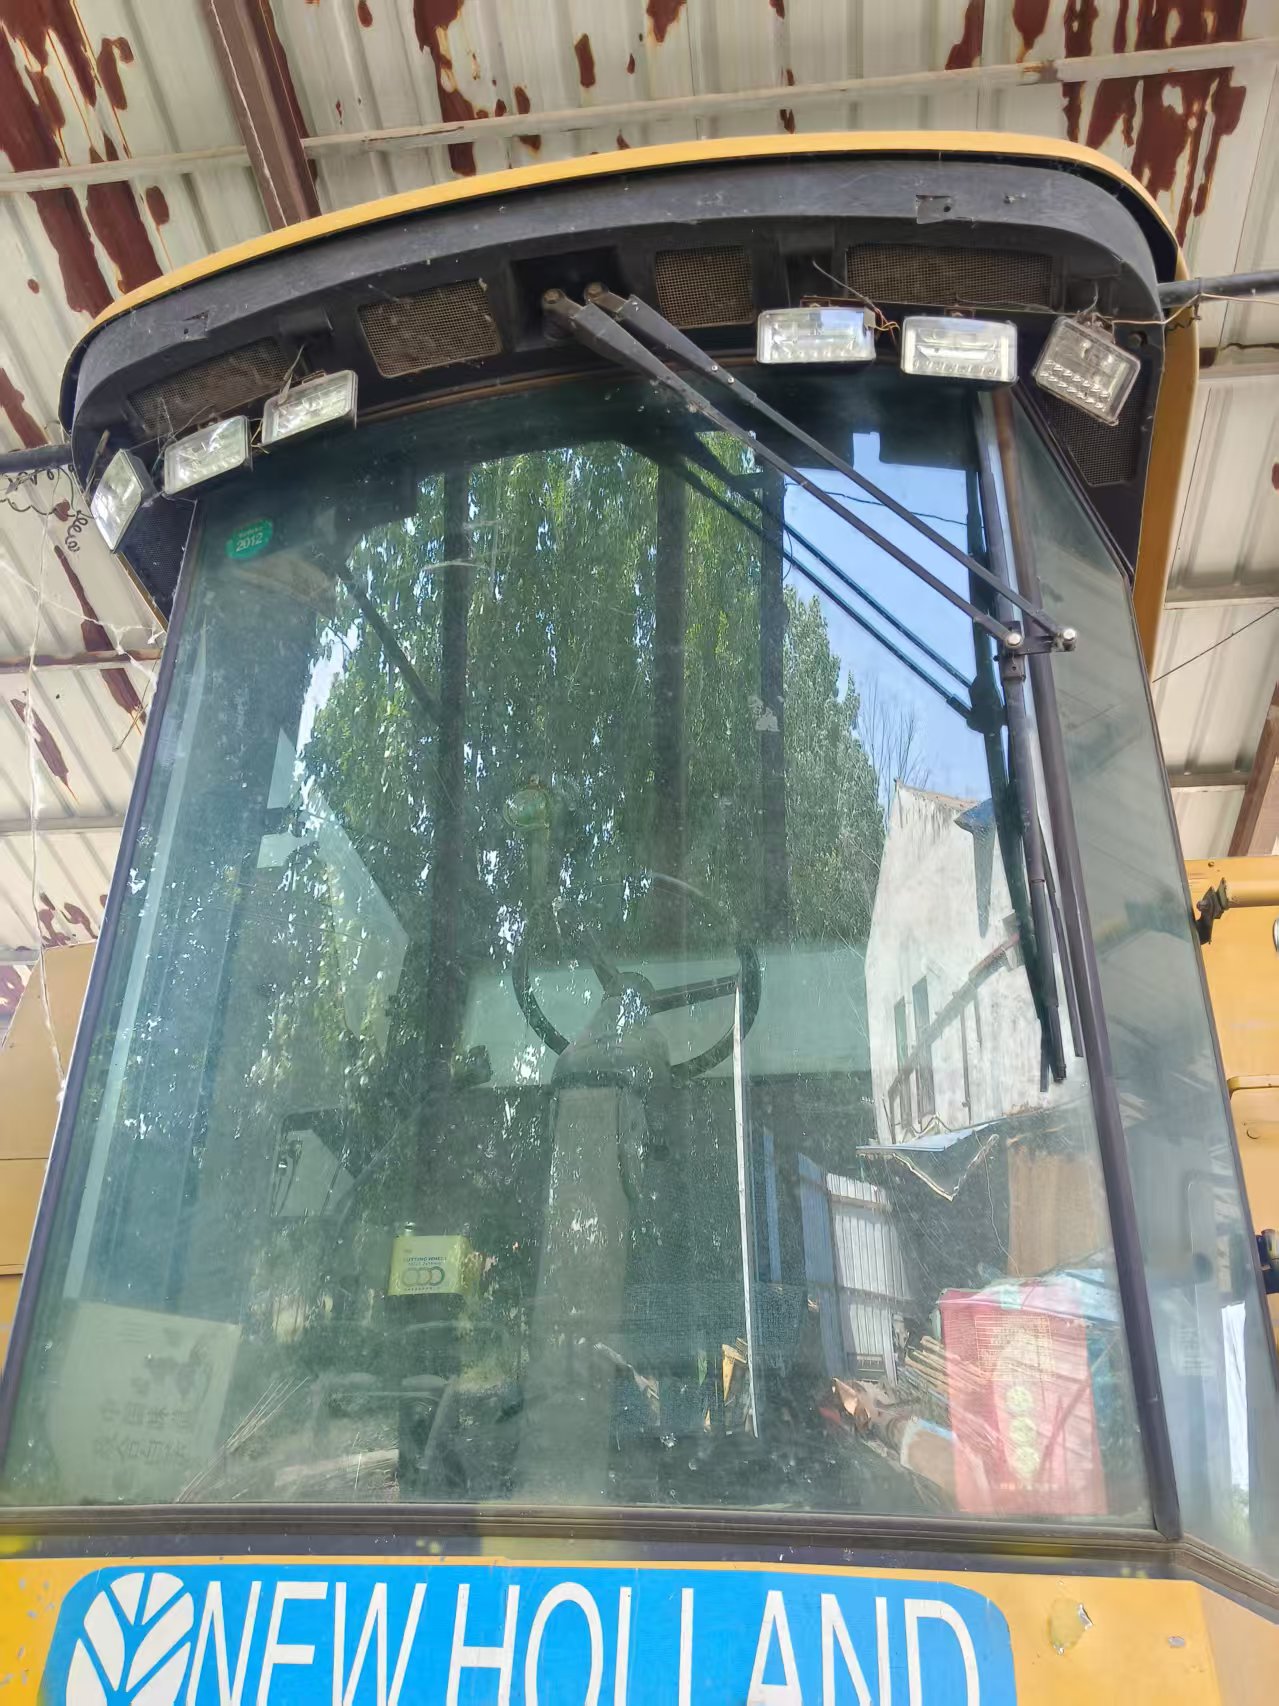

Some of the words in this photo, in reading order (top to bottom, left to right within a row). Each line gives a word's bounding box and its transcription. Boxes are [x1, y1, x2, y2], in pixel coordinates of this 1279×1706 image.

[235, 531, 263, 553] 2012
[186, 1580, 427, 1706] NEW
[446, 1581, 981, 1706] HOLLAND
